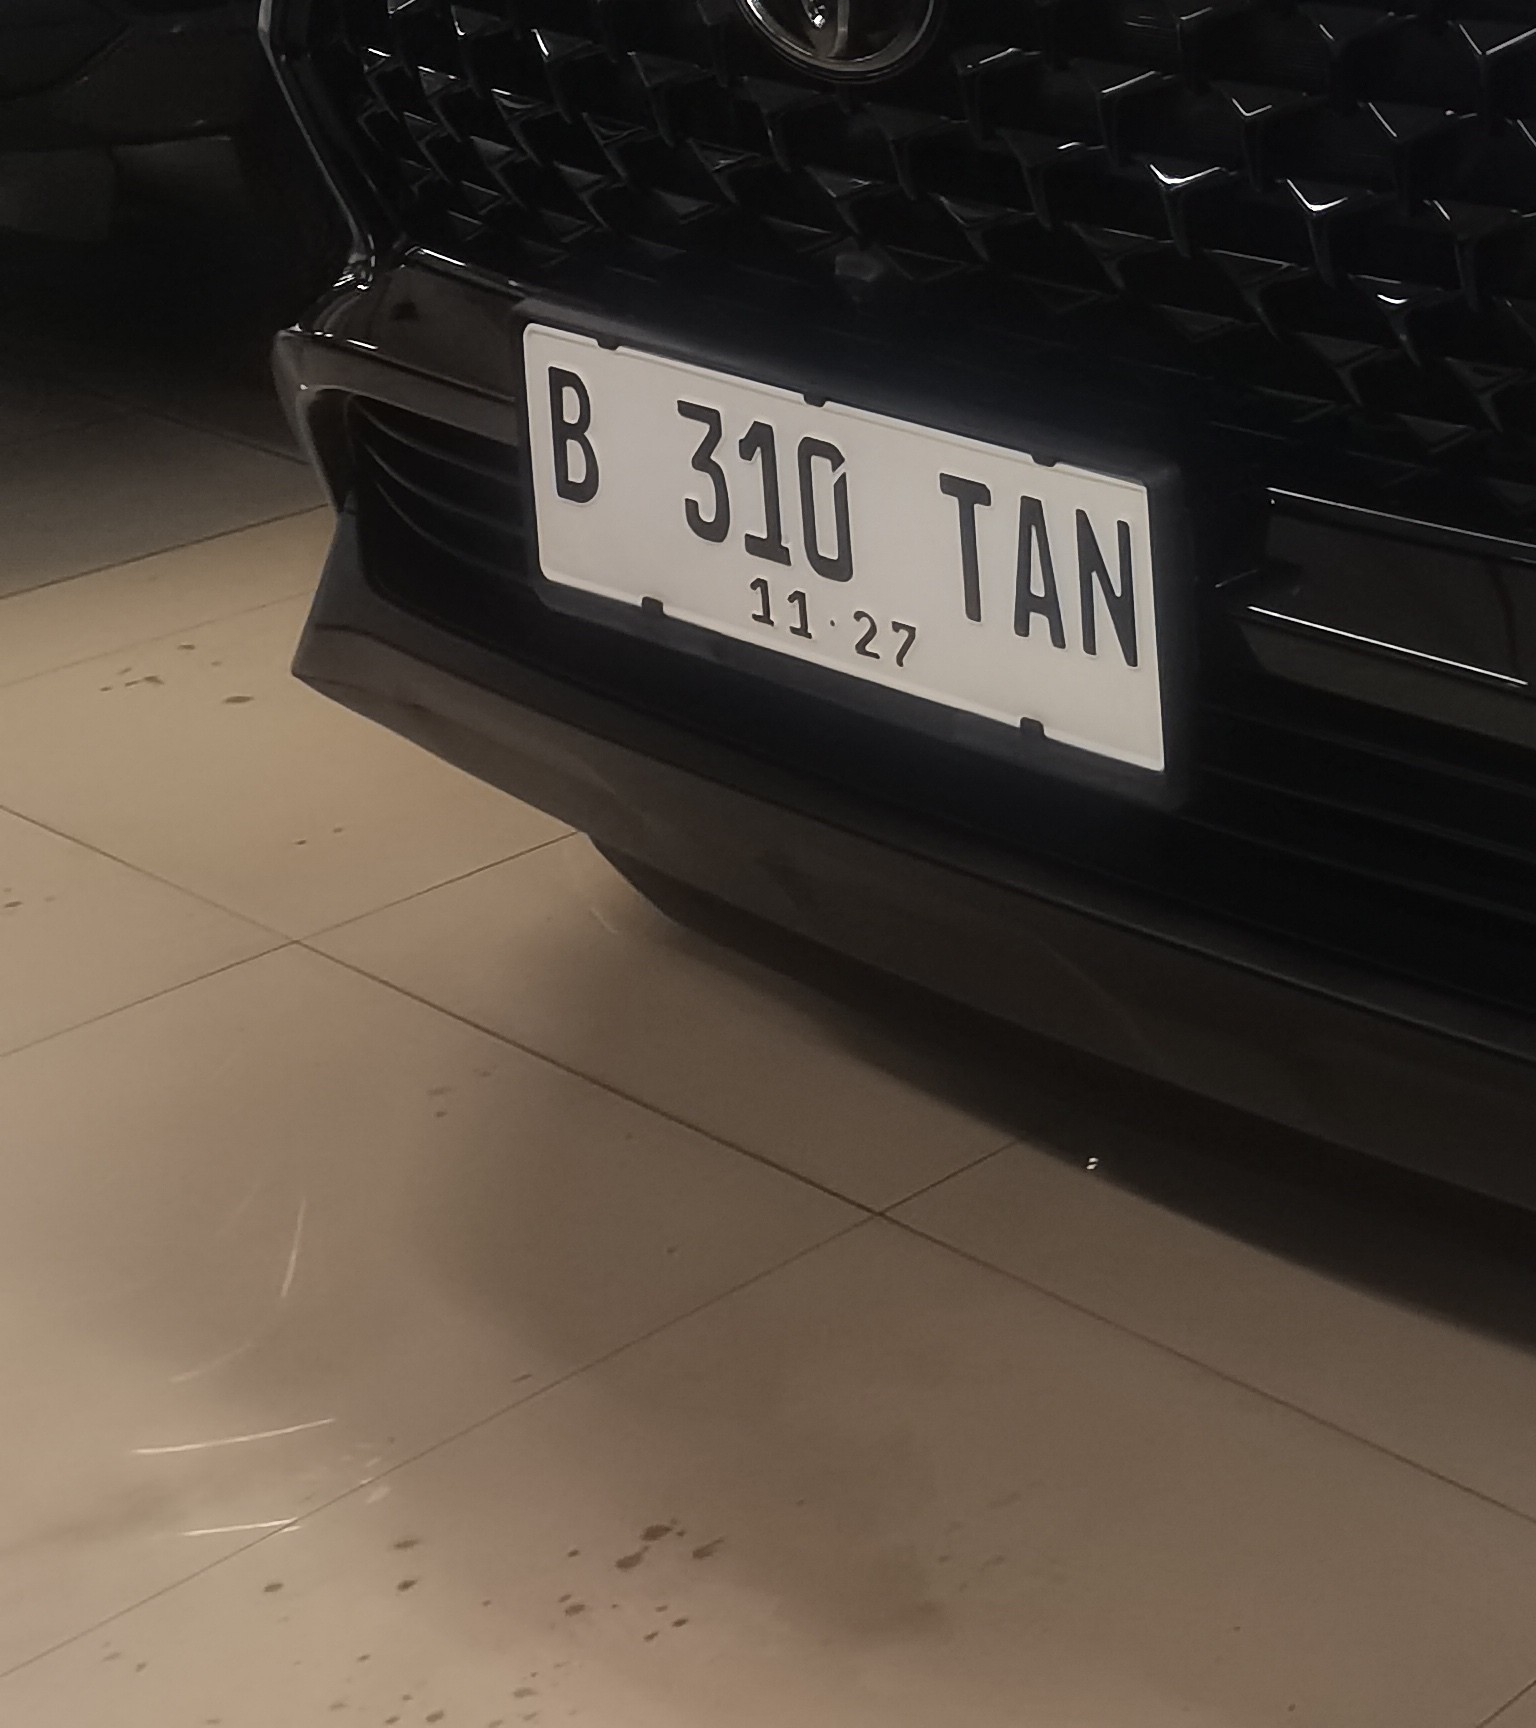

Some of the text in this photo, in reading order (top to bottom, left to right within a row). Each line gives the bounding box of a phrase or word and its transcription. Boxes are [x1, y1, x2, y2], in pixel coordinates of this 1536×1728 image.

[548, 365, 1140, 668] B 310 TAN
